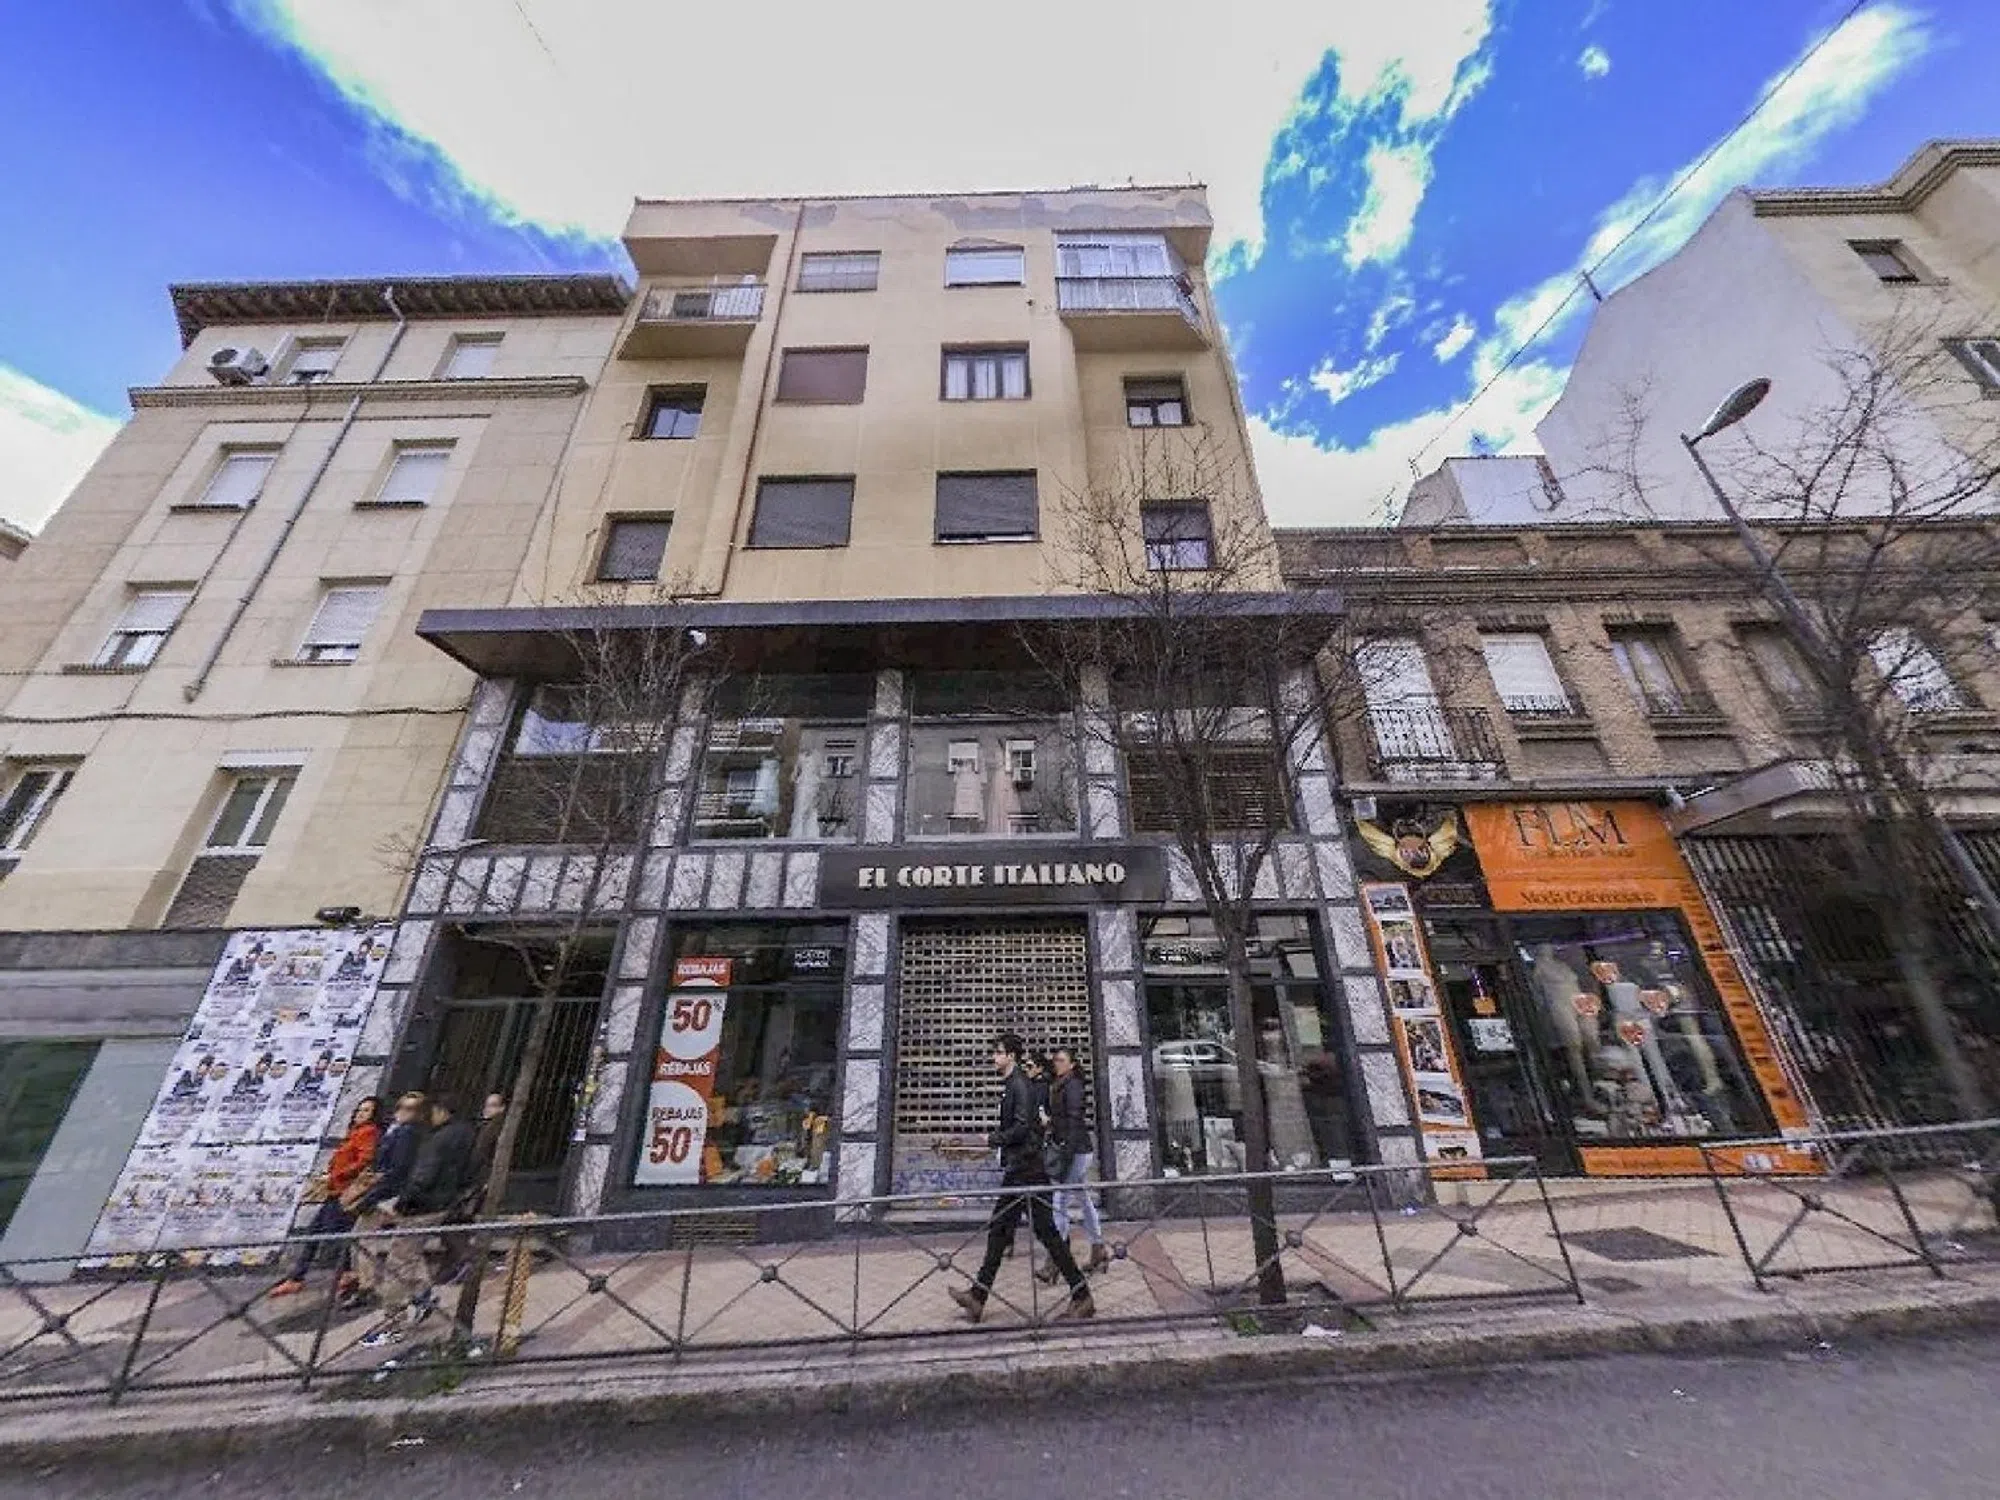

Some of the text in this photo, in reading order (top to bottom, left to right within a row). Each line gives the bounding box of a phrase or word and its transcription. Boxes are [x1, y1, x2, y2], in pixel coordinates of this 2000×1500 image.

[857, 862, 1126, 889] EL CORTE ITALIANO
